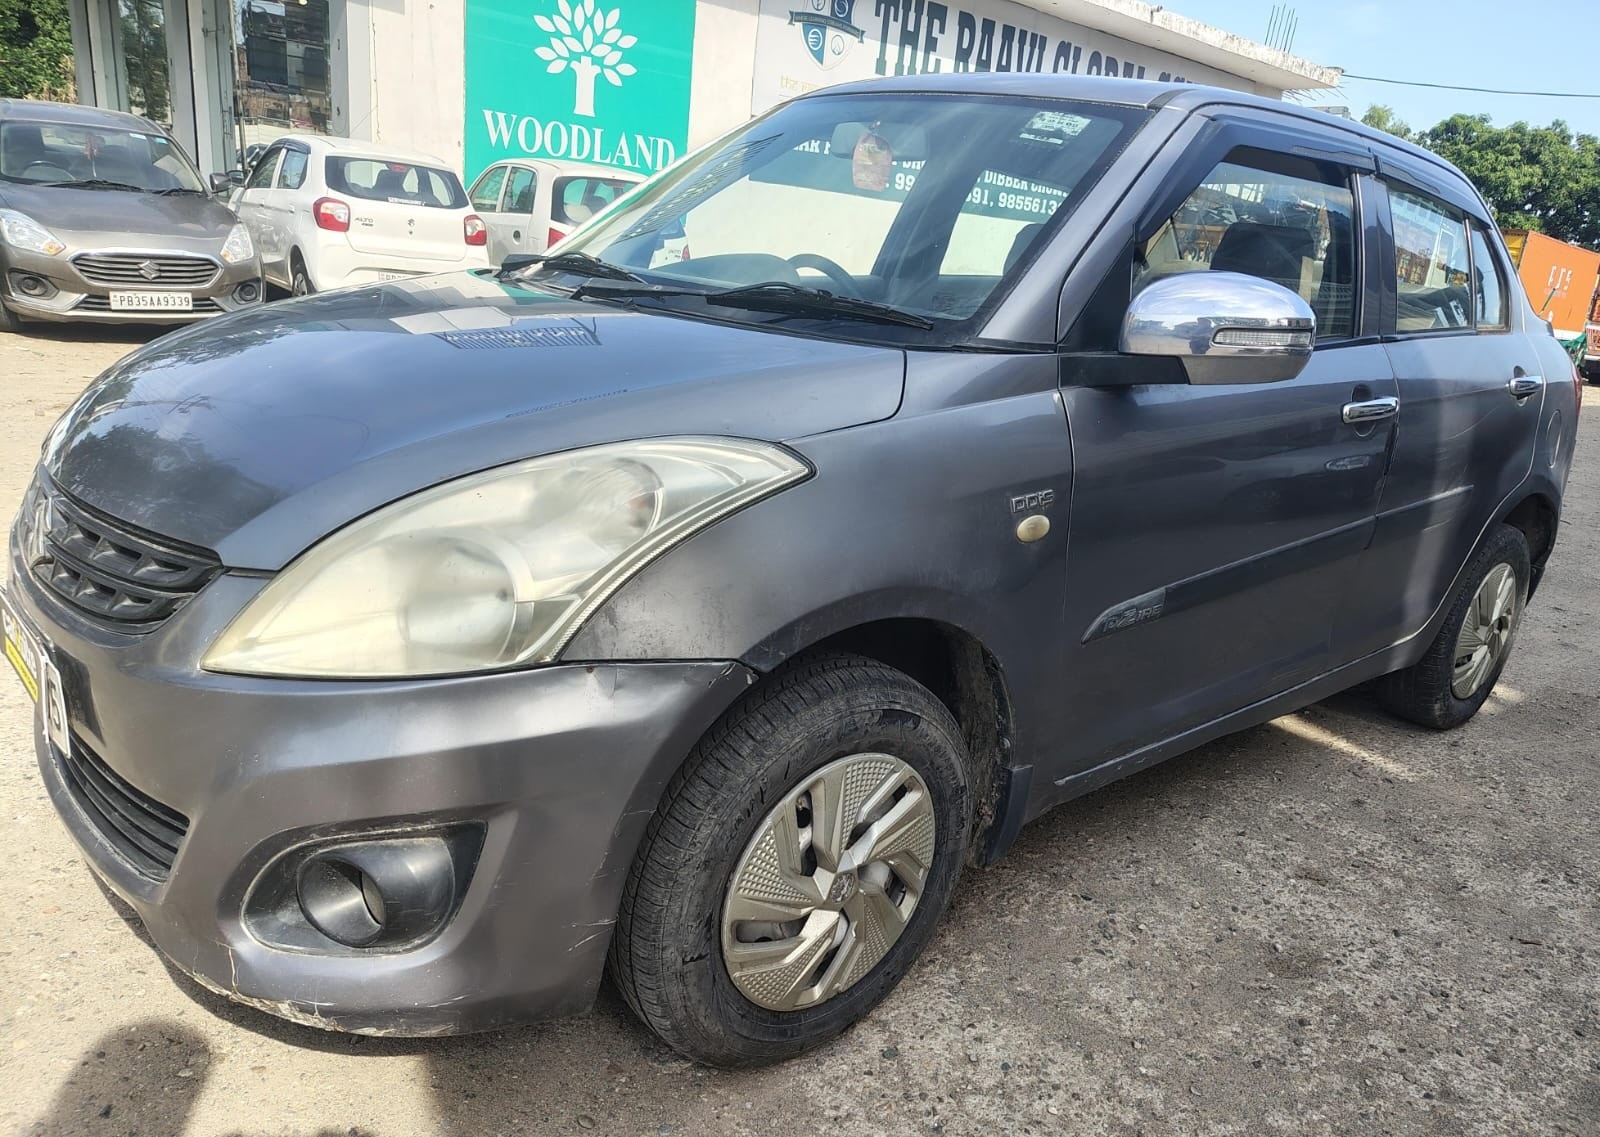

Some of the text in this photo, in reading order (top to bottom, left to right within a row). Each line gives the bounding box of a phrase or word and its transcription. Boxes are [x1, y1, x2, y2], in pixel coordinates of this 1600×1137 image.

[875, 0, 948, 76] THE
[483, 109, 676, 171] WOODLAND
[119, 295, 190, 307] PB35AA9339
